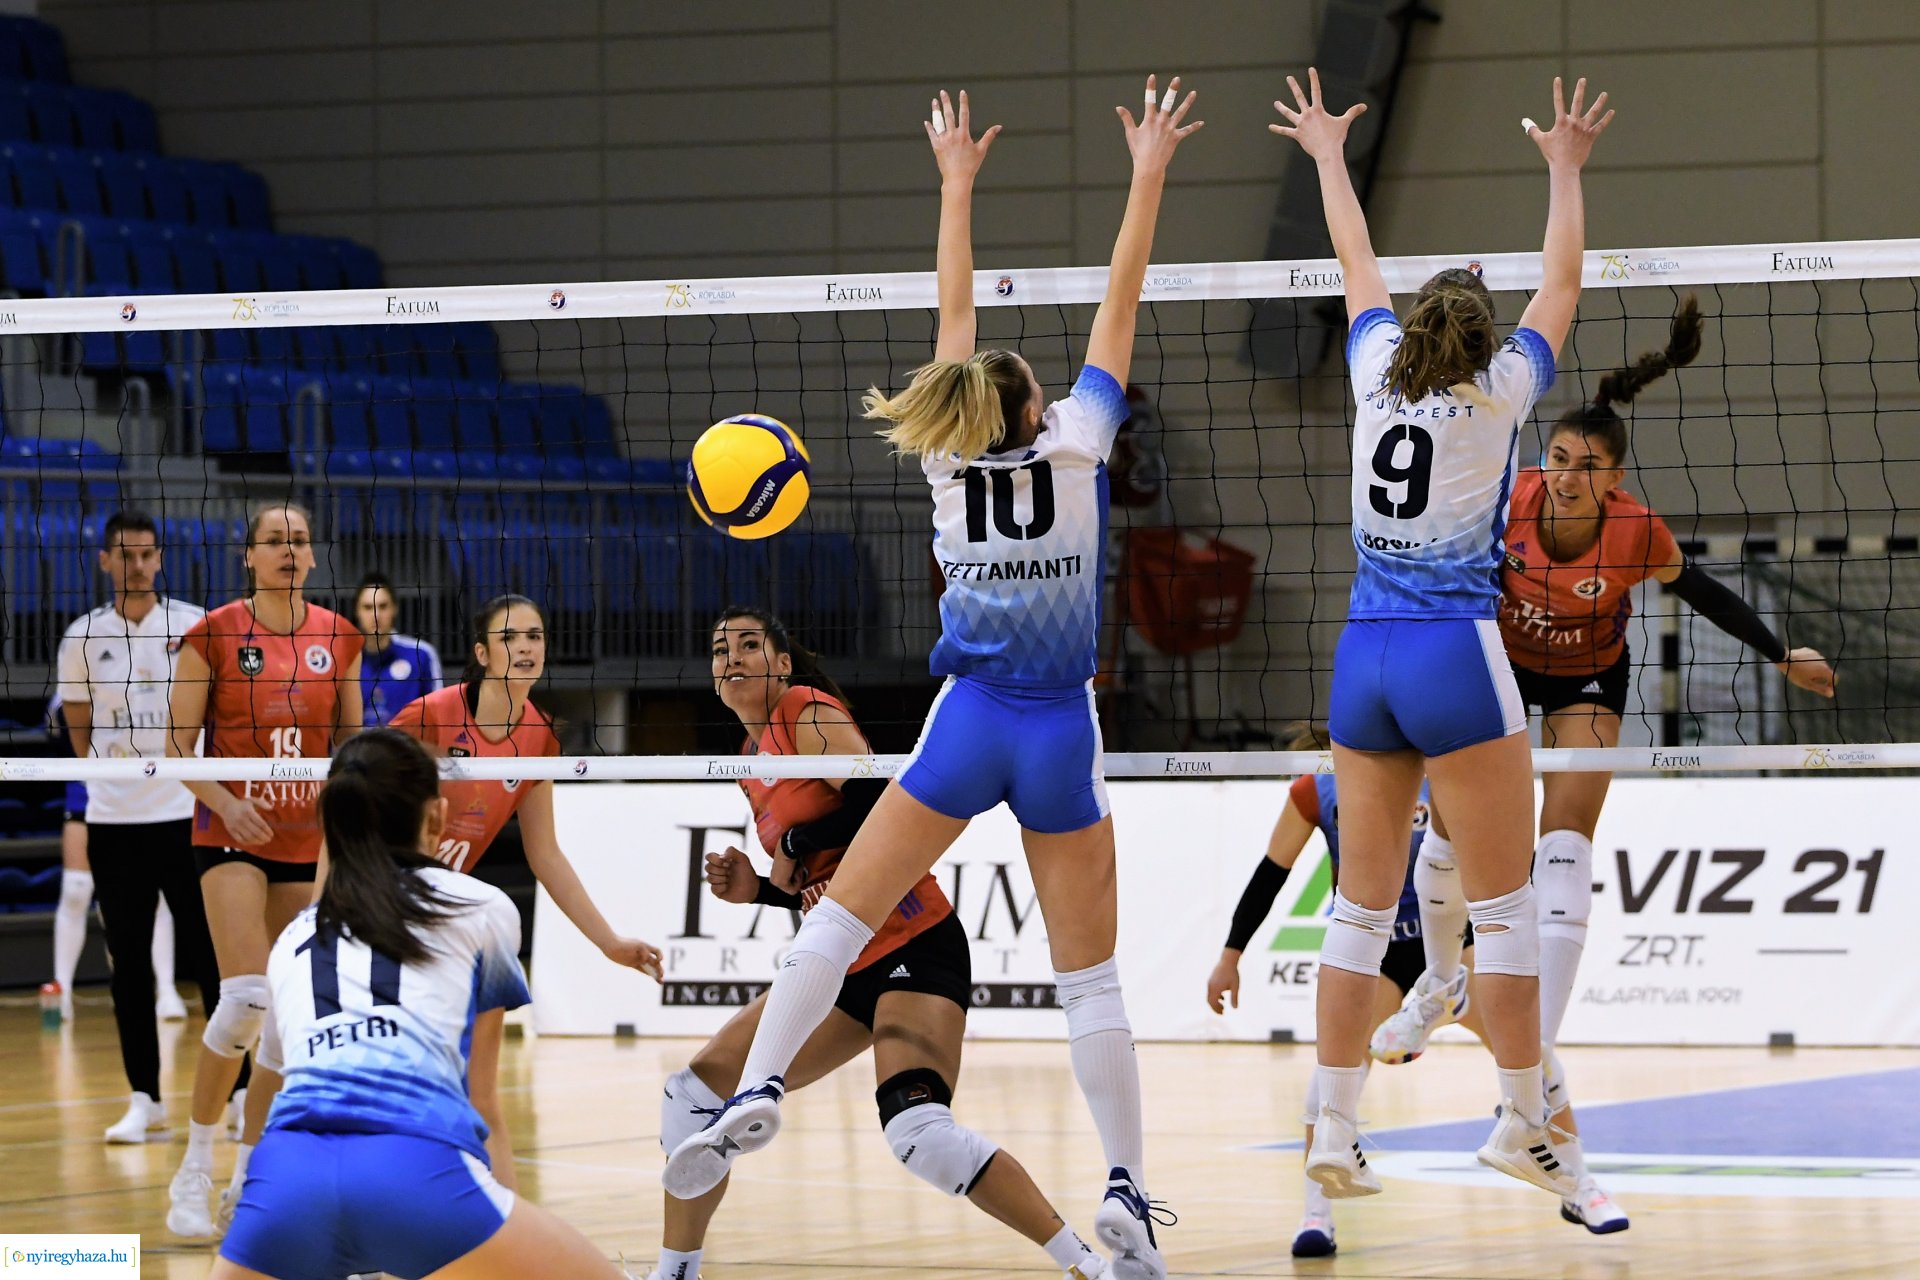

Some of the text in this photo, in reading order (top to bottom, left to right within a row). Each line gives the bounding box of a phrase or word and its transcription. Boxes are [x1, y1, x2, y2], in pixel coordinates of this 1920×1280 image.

[1770, 251, 1834, 271] FATUM
[825, 282, 883, 300] FATUM
[386, 296, 440, 313] FATUM
[1369, 424, 1434, 520] 9
[951, 460, 1055, 543] 10
[943, 555, 1081, 581] TETTAMANTI
[269, 726, 303, 758] 19
[270, 763, 313, 777] FATUM
[707, 761, 751, 775] FATUM
[1165, 757, 1211, 771] FATUM
[1650, 752, 1701, 767] FATUM
[1782, 848, 1886, 914] 21
[1618, 935, 1705, 966] ZRT.
[295, 930, 401, 1020] 11
[1697, 986, 1743, 1004] 1991
[309, 1016, 399, 1058] PETRI
